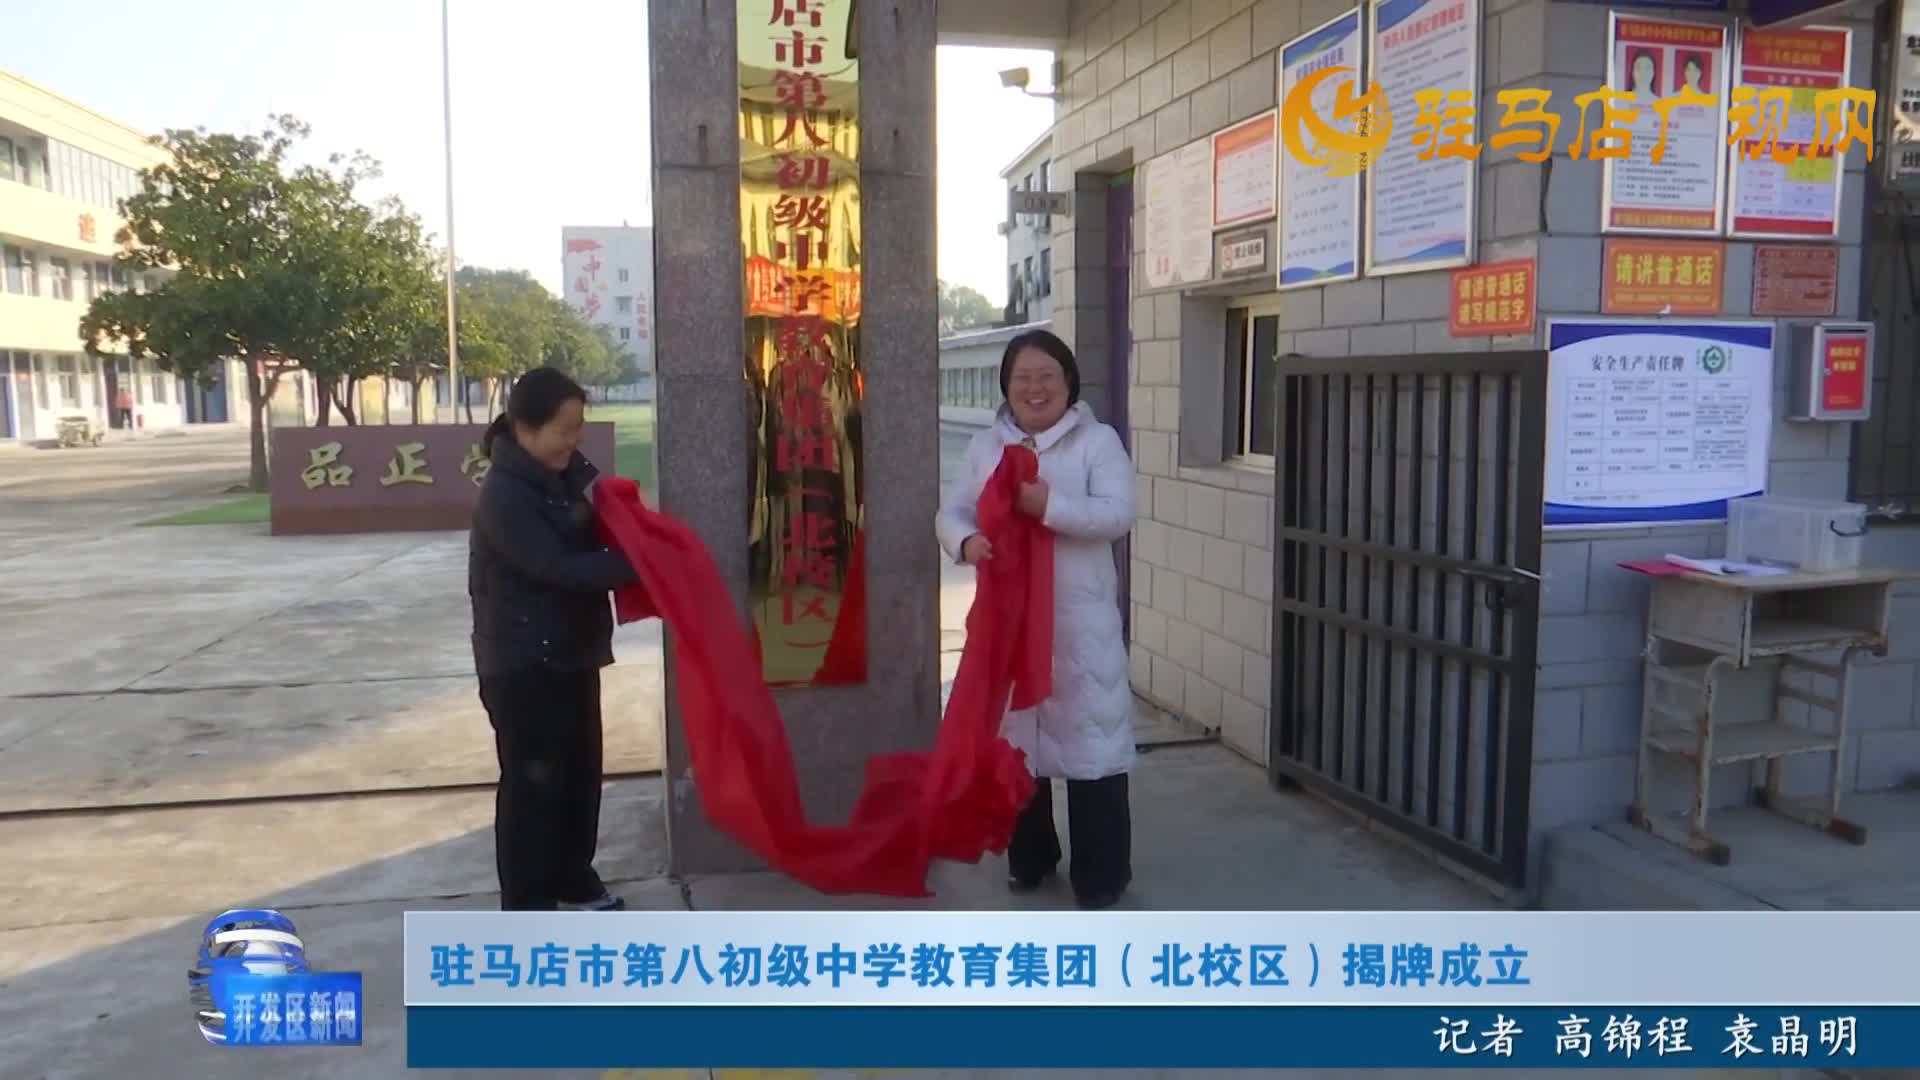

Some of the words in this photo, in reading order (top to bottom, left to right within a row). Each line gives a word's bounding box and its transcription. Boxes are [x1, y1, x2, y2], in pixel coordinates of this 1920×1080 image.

[1615, 254, 1714, 286] 请讲普通话
[1458, 271, 1526, 300] 请讲普通话
[1457, 298, 1526, 325] 请写规范字
[1591, 353, 1685, 373] 安全生产责任牌
